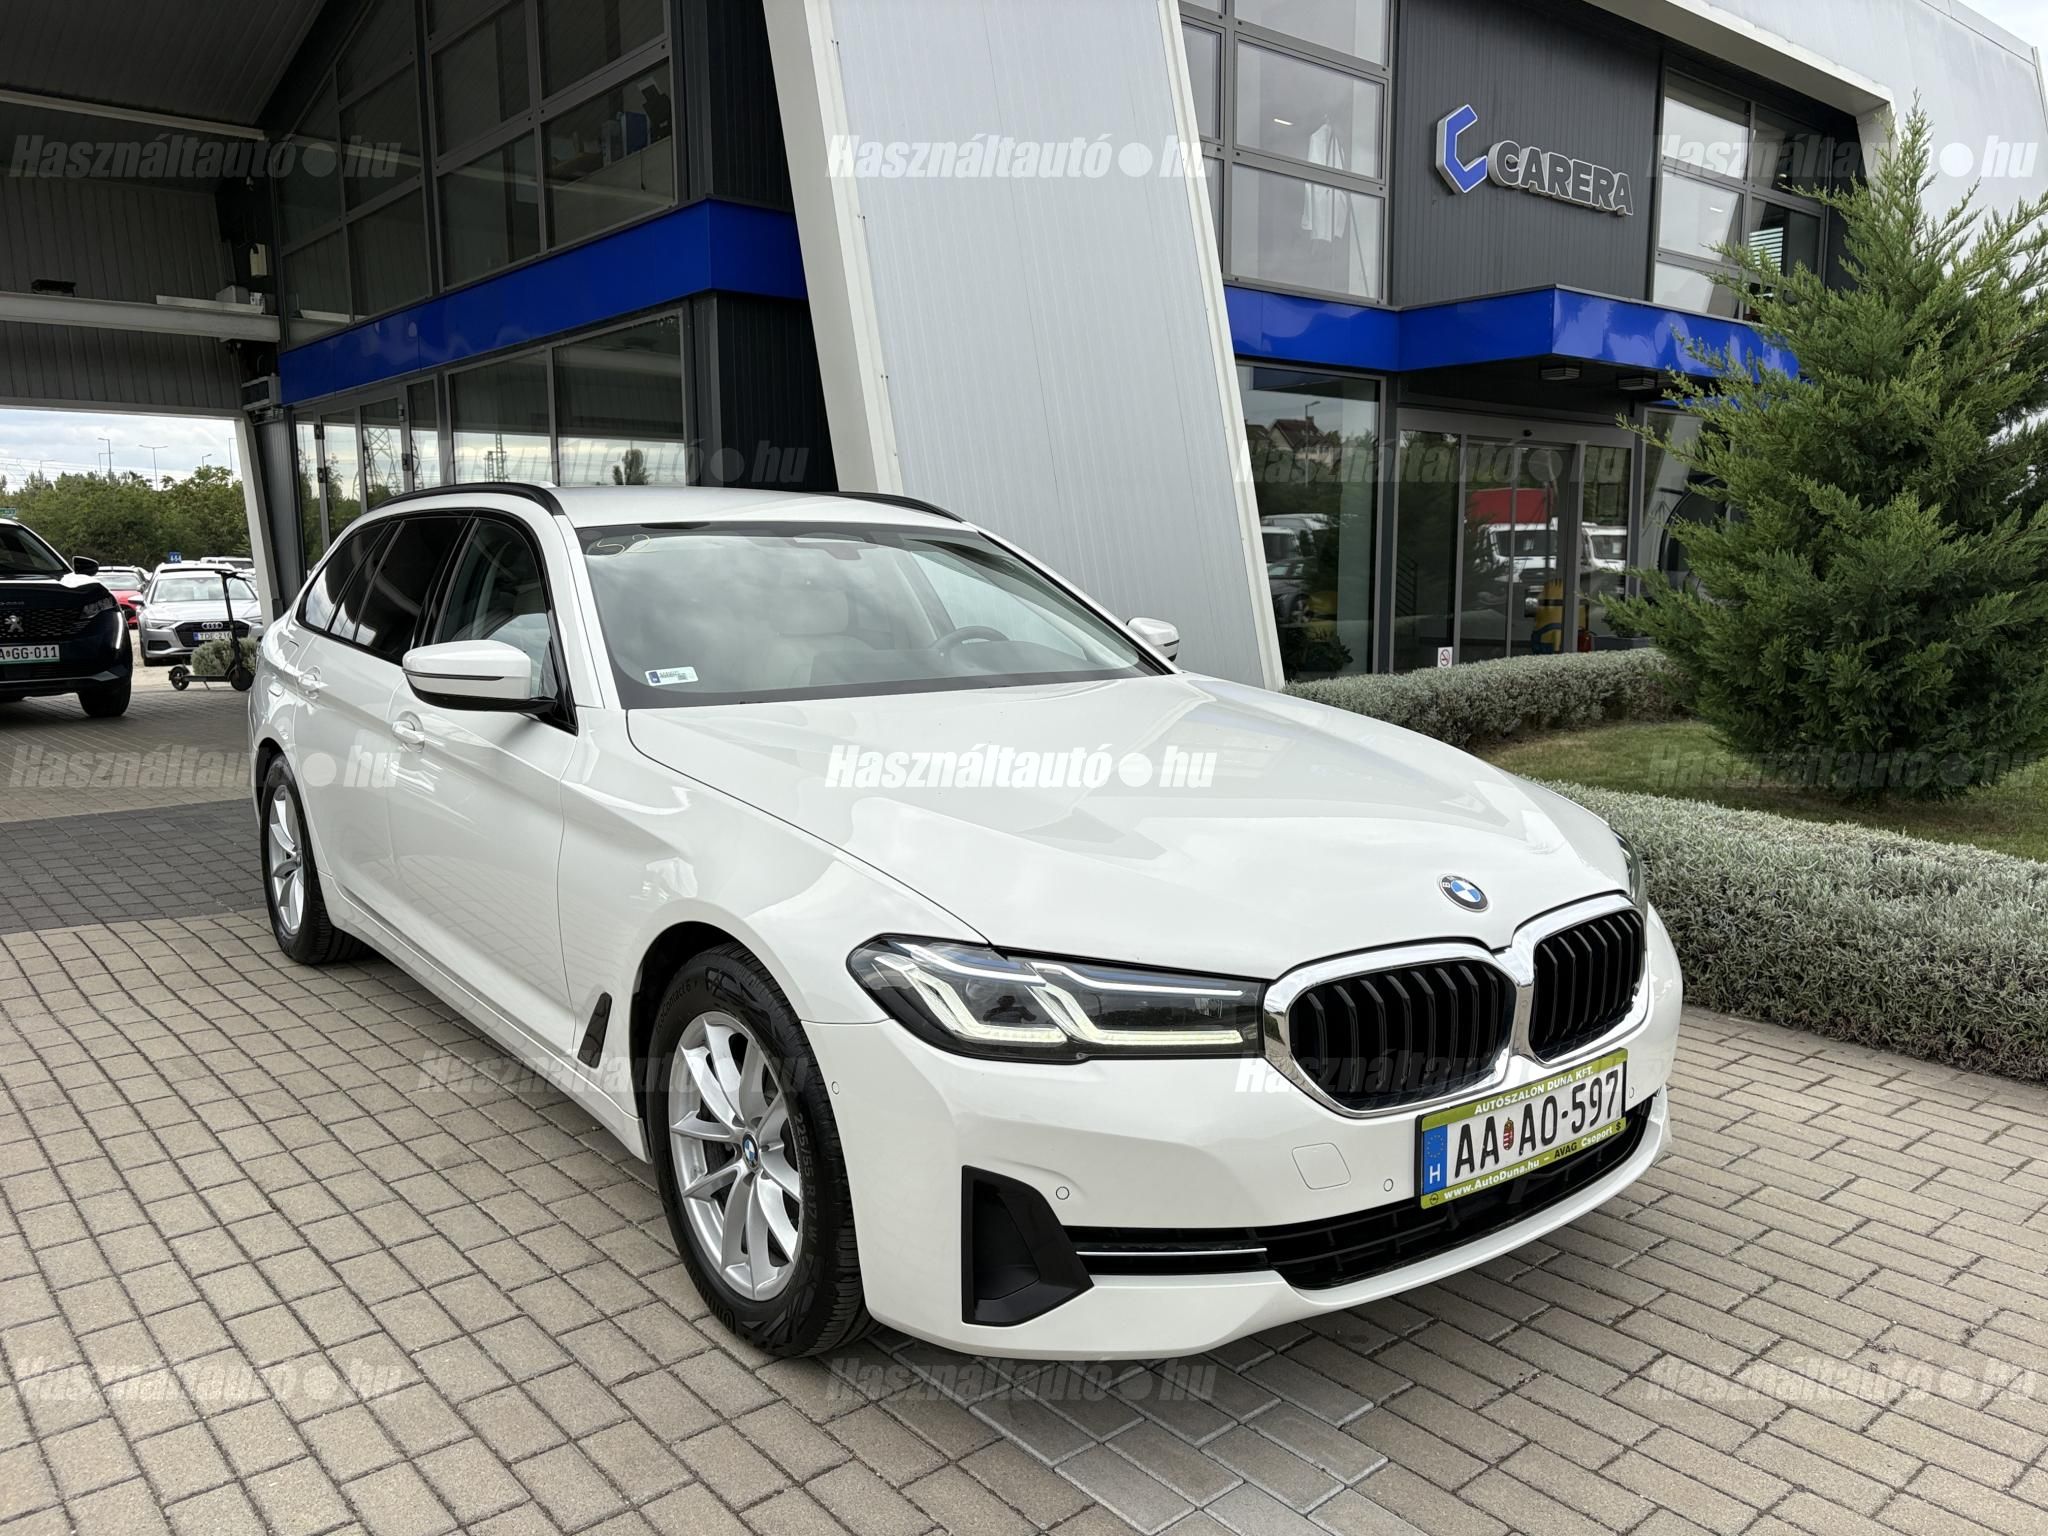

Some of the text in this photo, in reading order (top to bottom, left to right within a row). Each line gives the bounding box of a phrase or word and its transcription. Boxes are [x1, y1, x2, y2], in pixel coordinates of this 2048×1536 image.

[1488, 140, 1634, 216] CARERA
[1474, 1066, 1594, 1116] AUTOSZALON DUNA KFT.
[1429, 1163, 1441, 1185] H
[1443, 1158, 1540, 1200] www.AutoDuna.hu
[1554, 1142, 1578, 1159] AVAG
[1581, 1125, 1613, 1147] Csoport
[1455, 1115, 1500, 1179] AA
